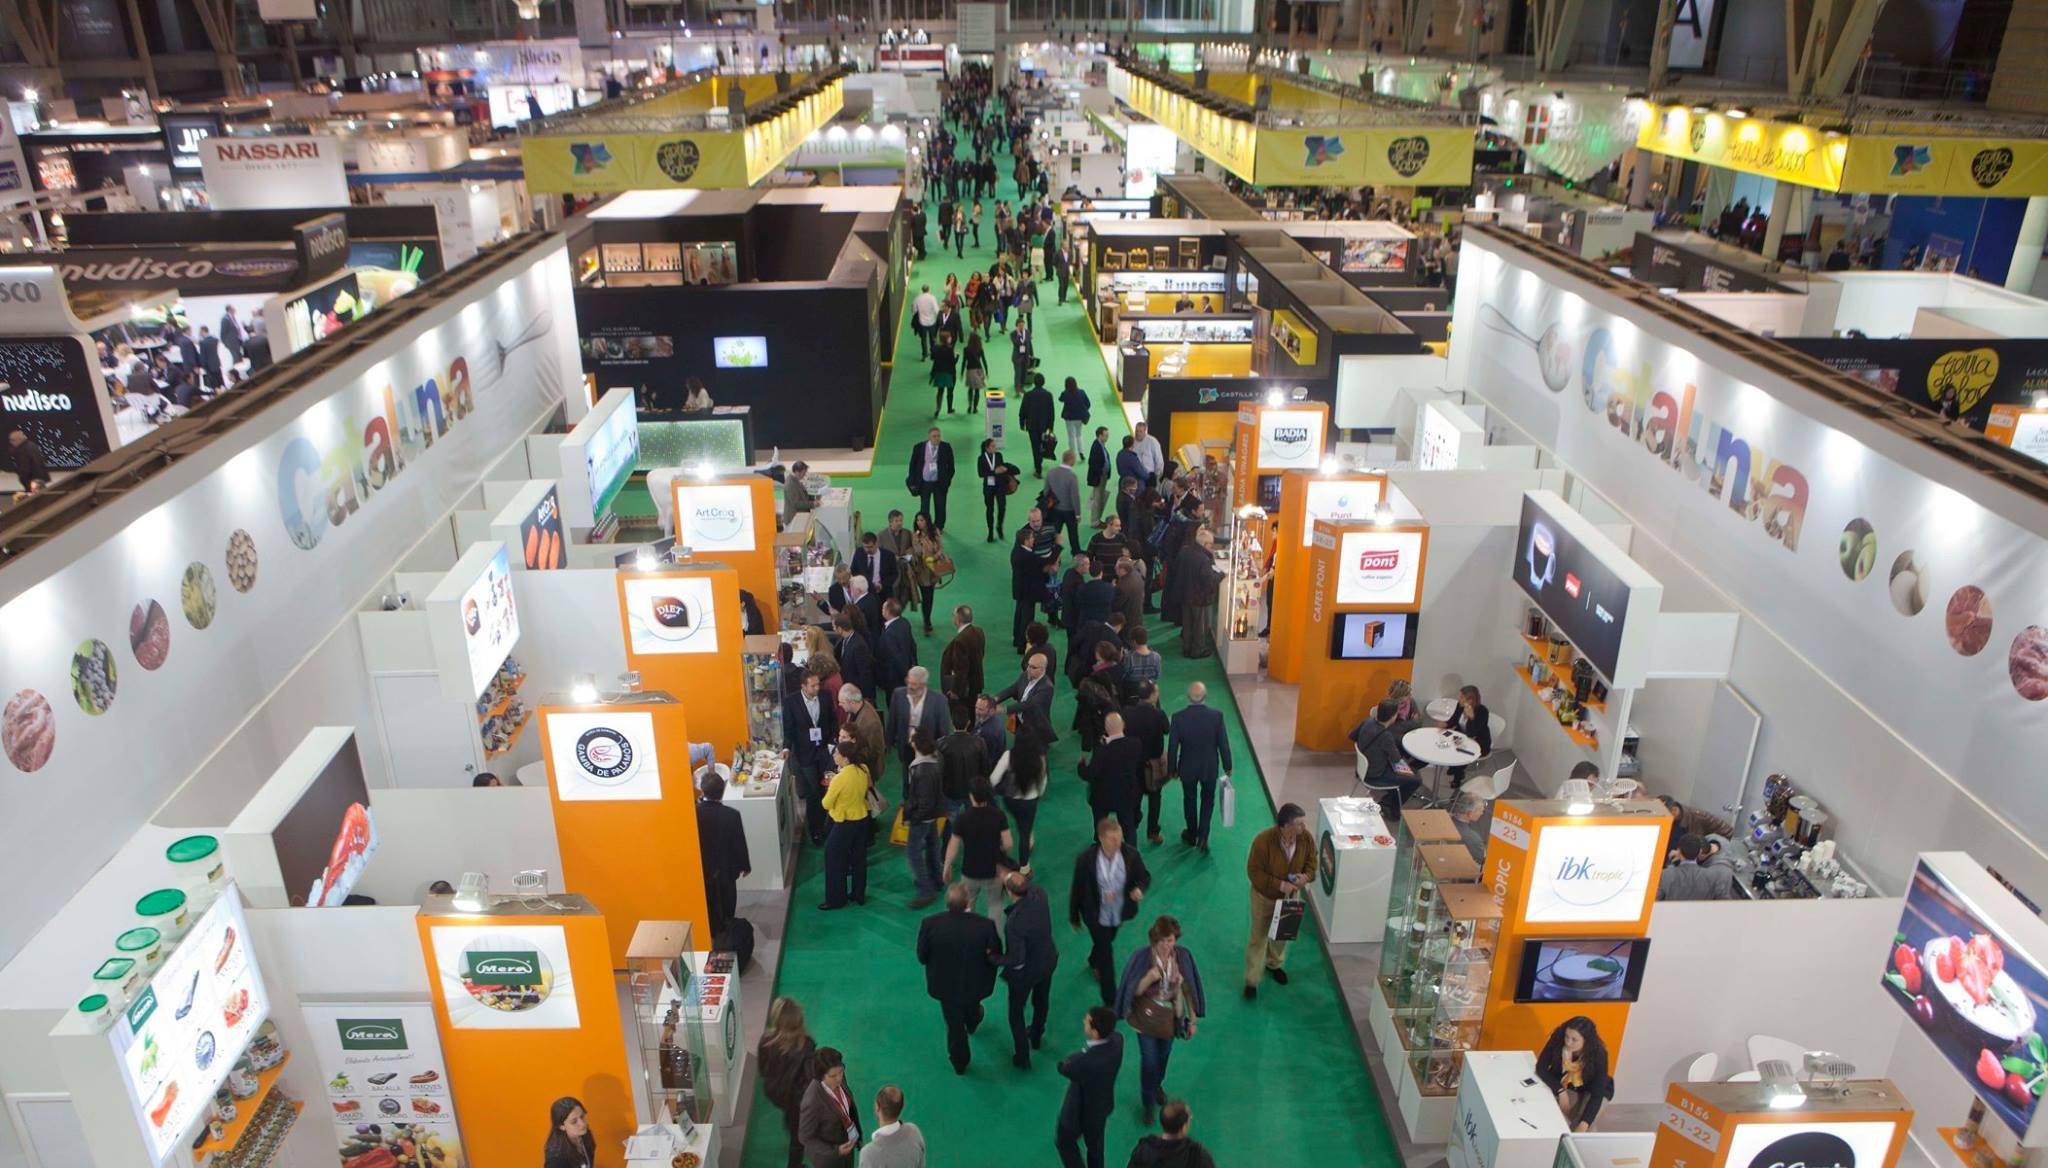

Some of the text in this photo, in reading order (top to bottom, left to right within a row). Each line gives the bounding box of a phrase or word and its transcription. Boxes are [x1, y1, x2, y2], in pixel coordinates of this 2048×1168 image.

[216, 142, 320, 161] NASSARI
[62, 256, 214, 281] nudisco
[2, 389, 72, 412] nudisco
[1582, 328, 1810, 552] Catalunya
[278, 356, 474, 551] Catalunya
[1363, 556, 1396, 569] pont
[656, 604, 684, 616] DIET
[577, 743, 595, 772] GAMBA
[597, 768, 610, 777] DE
[1557, 856, 1625, 882] ibk tropic
[1680, 1097, 1710, 1121] B156
[1668, 1112, 1712, 1145] 21-22
